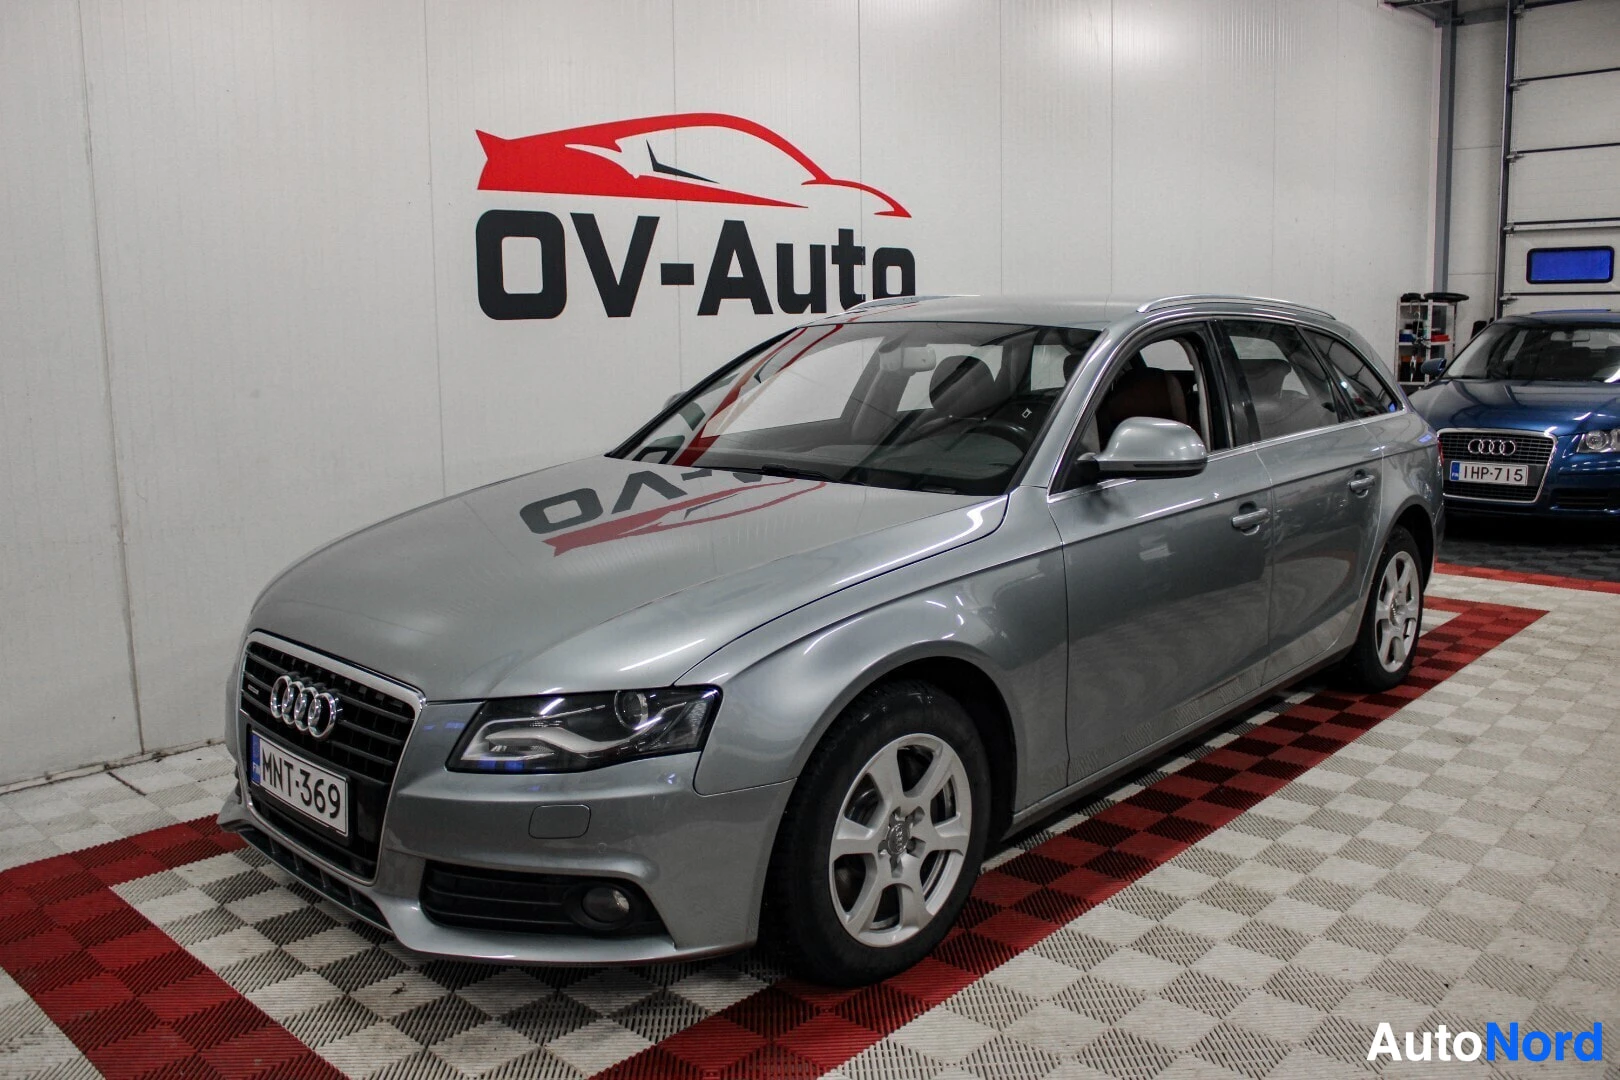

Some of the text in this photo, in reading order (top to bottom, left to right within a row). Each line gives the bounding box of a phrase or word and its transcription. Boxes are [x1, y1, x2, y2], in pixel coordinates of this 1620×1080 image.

[475, 209, 916, 320] OV-Auto
[1463, 465, 1524, 482] IHP-715
[262, 747, 341, 819] MNT-369
